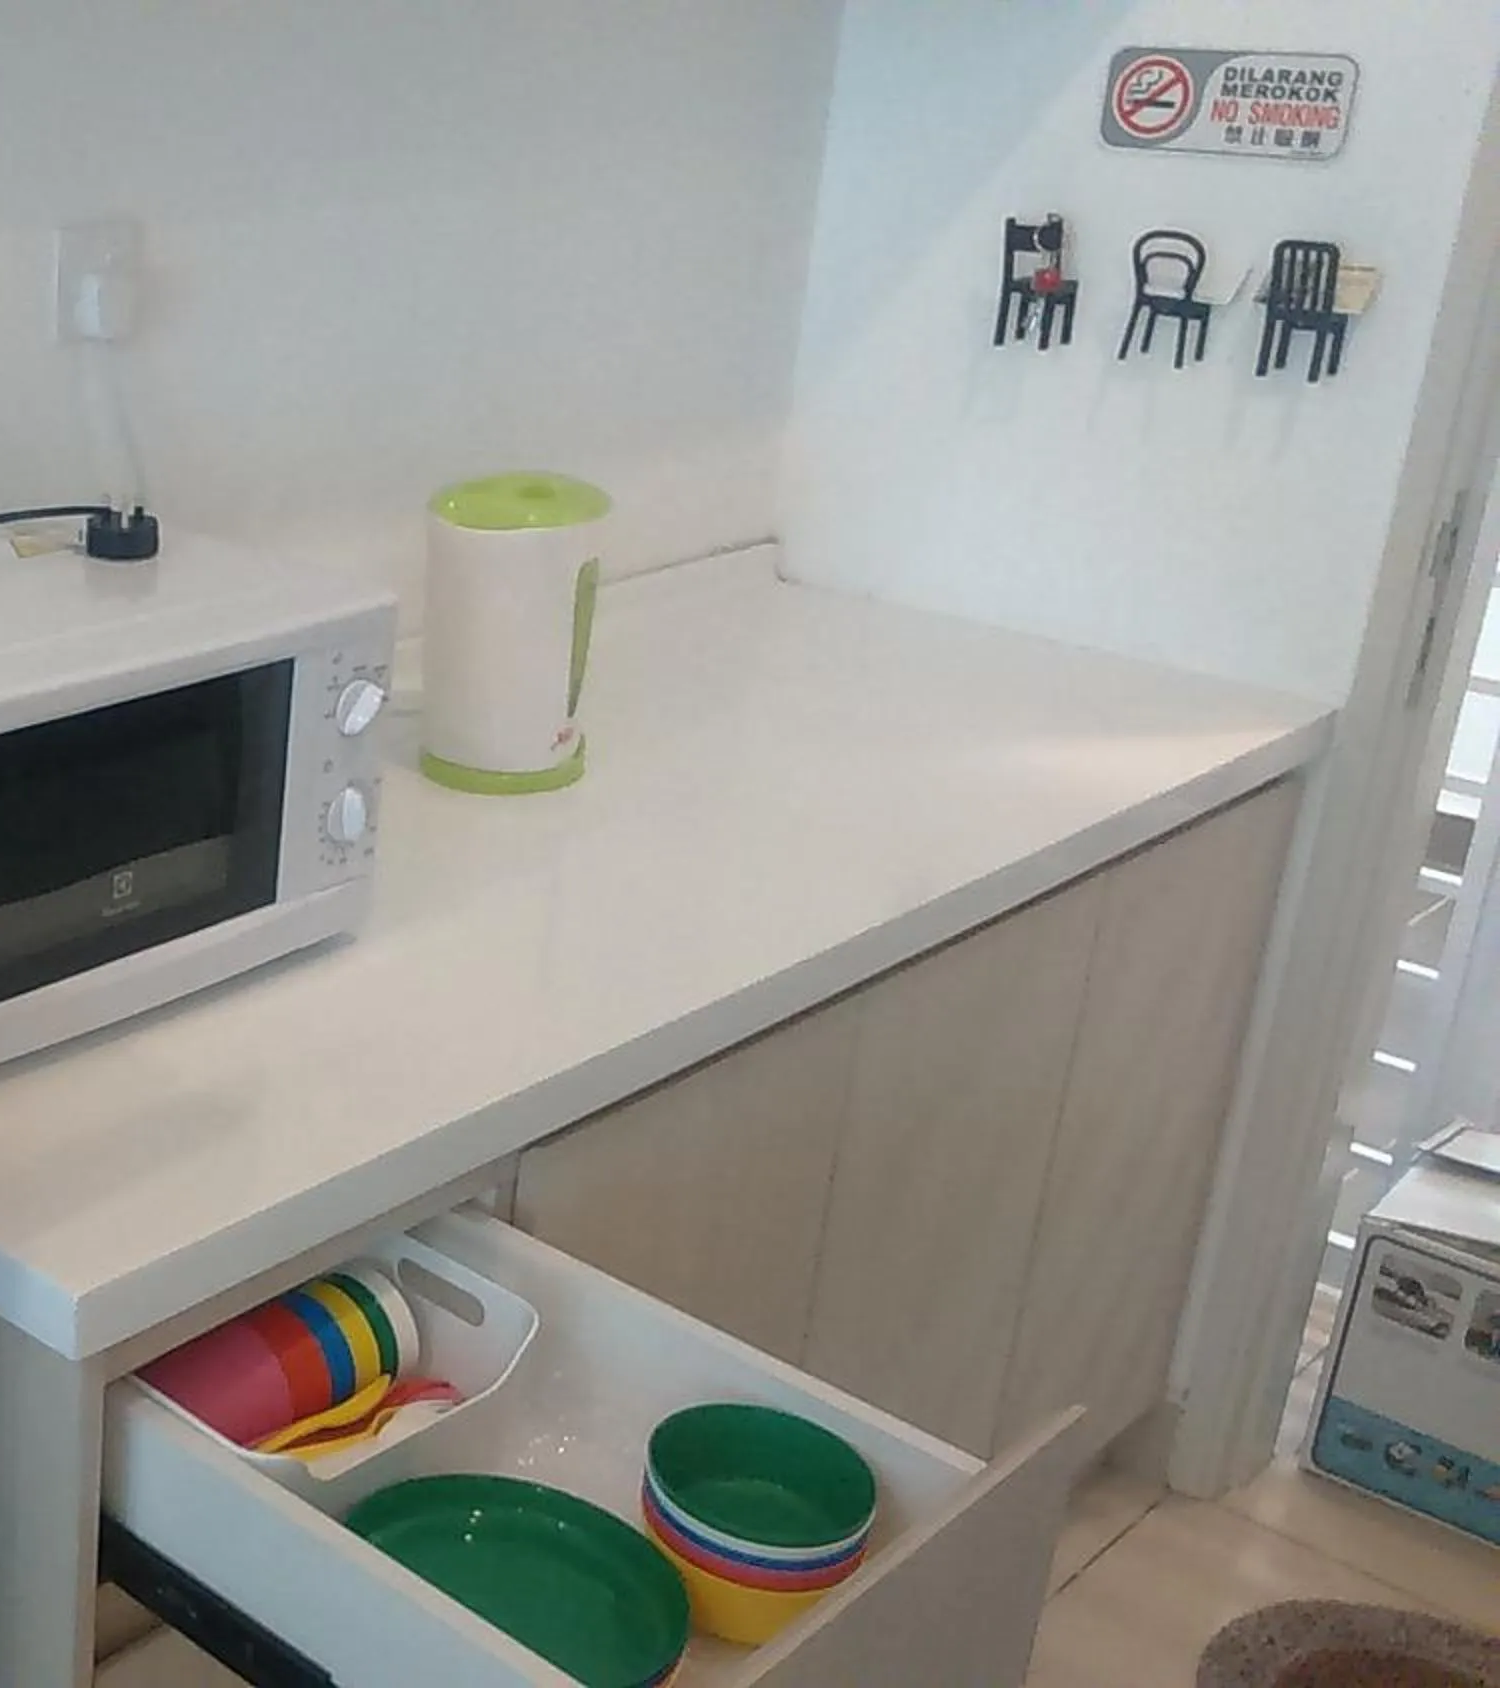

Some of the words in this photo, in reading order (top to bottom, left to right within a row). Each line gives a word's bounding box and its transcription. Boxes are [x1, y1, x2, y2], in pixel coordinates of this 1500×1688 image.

[1223, 66, 1343, 86] DILARANG
[1220, 83, 1339, 102] MEROKOK
[1210, 99, 1239, 122] NO
[1247, 103, 1341, 129] SMOKING
